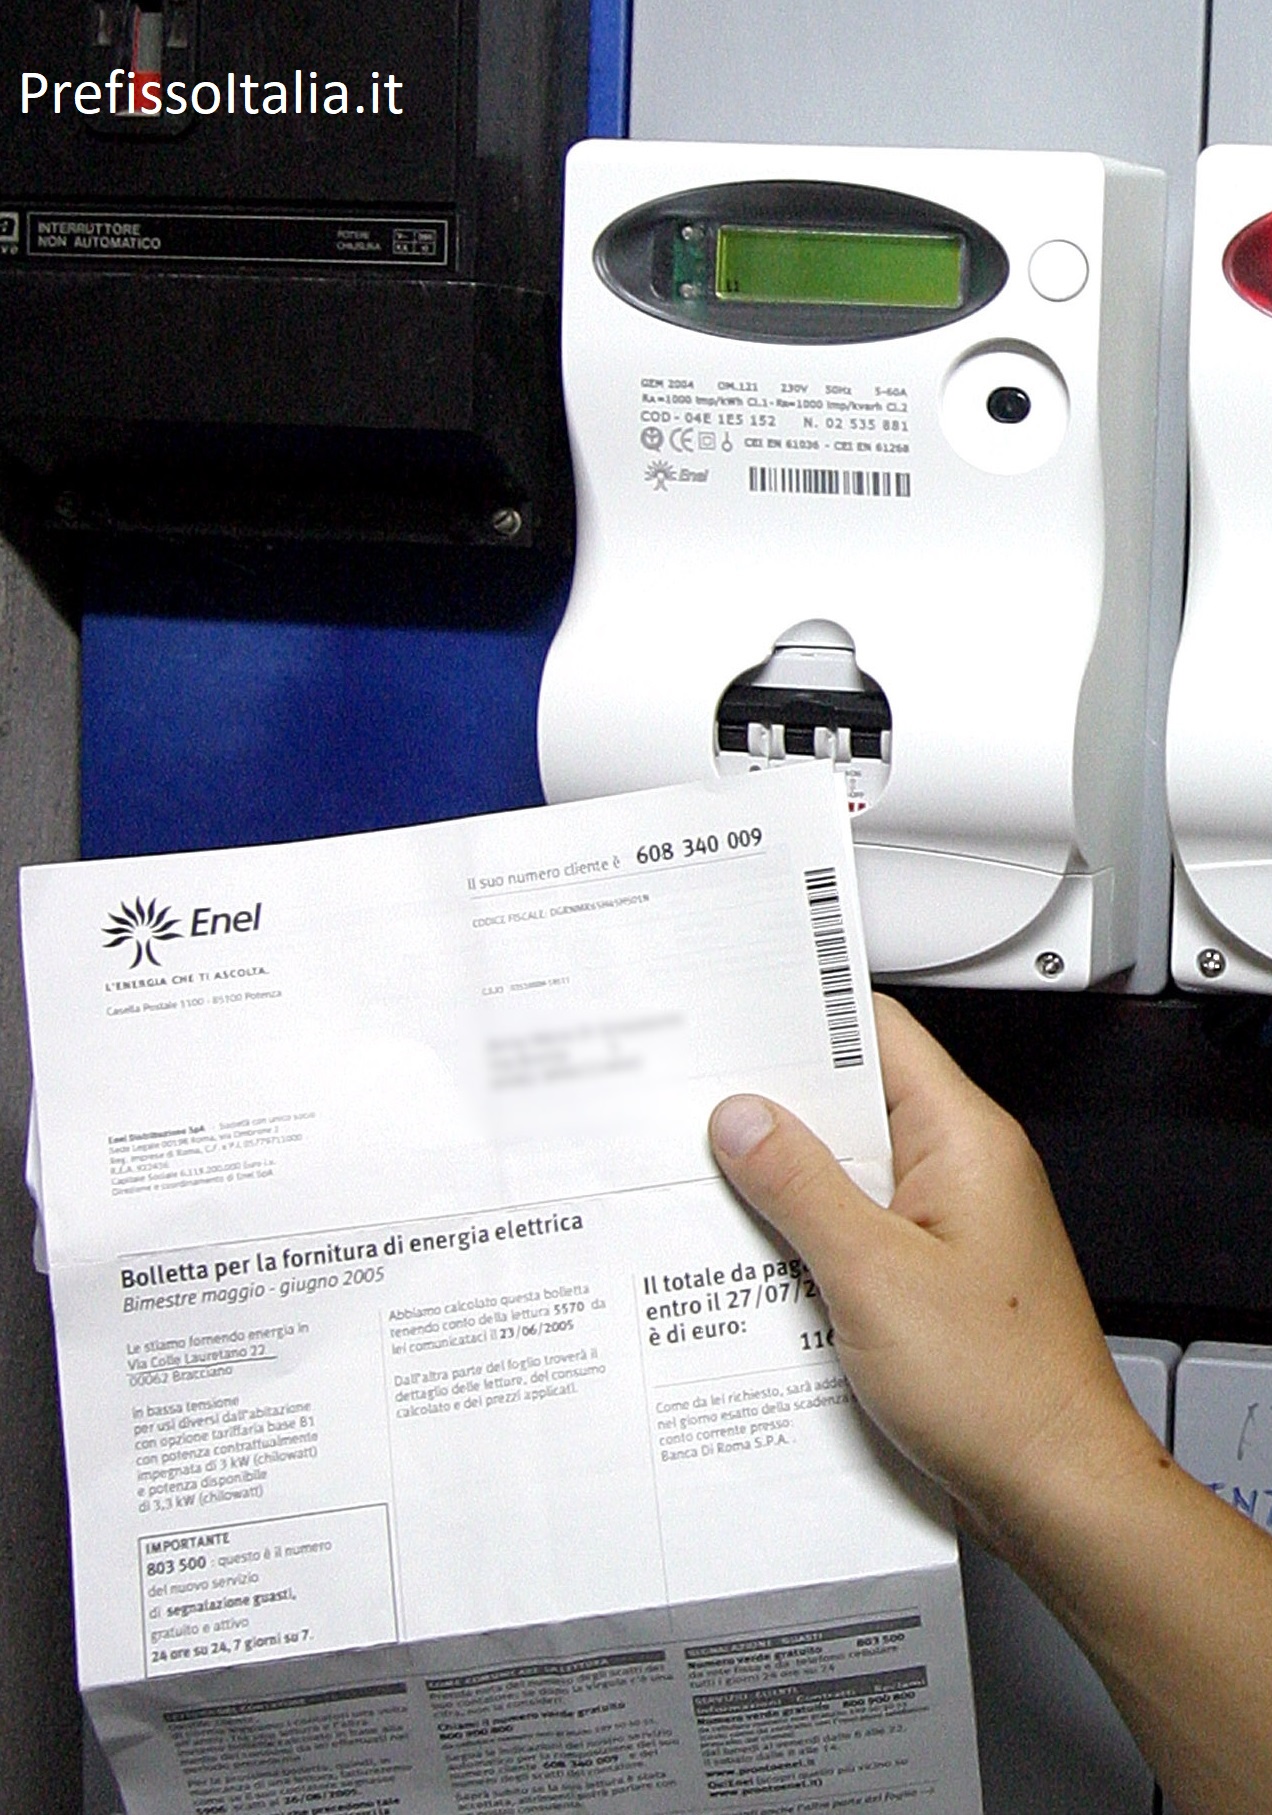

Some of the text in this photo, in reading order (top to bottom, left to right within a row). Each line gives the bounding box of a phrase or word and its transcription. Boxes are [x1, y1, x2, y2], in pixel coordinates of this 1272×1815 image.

[37, 236, 161, 250] NON AUTOMATICO
[667, 379, 695, 389] 2004
[781, 383, 809, 393] 230V
[640, 411, 672, 423] COD
[684, 413, 712, 424] 04E
[749, 415, 777, 427] 152
[803, 417, 818, 428] N.
[825, 418, 843, 429] 02
[850, 419, 876, 430] 535
[882, 420, 909, 432] 881
[466, 828, 763, 890] Il suo numero cliente è 608 340 009
[190, 902, 263, 937] Enel
[105, 976, 167, 991] L'ENERGIA
[171, 973, 193, 984] CHE
[199, 972, 209, 981] TI
[119, 1213, 583, 1288] Bolletta per la fornitura di energia elettrica
[121, 1290, 198, 1313] Bimestre
[200, 1281, 265, 1306] maggio
[279, 1277, 339, 1300] giugno
[341, 1266, 385, 1287] 2005
[643, 1275, 657, 1294] Il
[662, 1268, 725, 1292] totale
[729, 1264, 756, 1283] da
[387, 1284, 590, 1321] Abbiamo calcolato questa bolletta
[645, 1298, 702, 1320] entro
[726, 1280, 820, 1309] 27/07/2
[389, 1300, 606, 1338] tenendo conto della lettura 5570 da
[647, 1320, 746, 1346] è di euro:
[391, 1342, 406, 1354] lei
[409, 1331, 487, 1352] comunicataci
[499, 1320, 574, 1340] 23/06/2005
[127, 1344, 266, 1371] Via Colle Lauretano 22
[145, 1532, 229, 1555] IMPORTANTE
[145, 1561, 175, 1576] 803
[178, 1557, 207, 1572] 500
[217, 1550, 260, 1570] questo
[262, 1547, 271, 1560] è
[284, 1543, 332, 1557] numero
[148, 1606, 160, 1619] di
[166, 1598, 250, 1618] segnalazione
